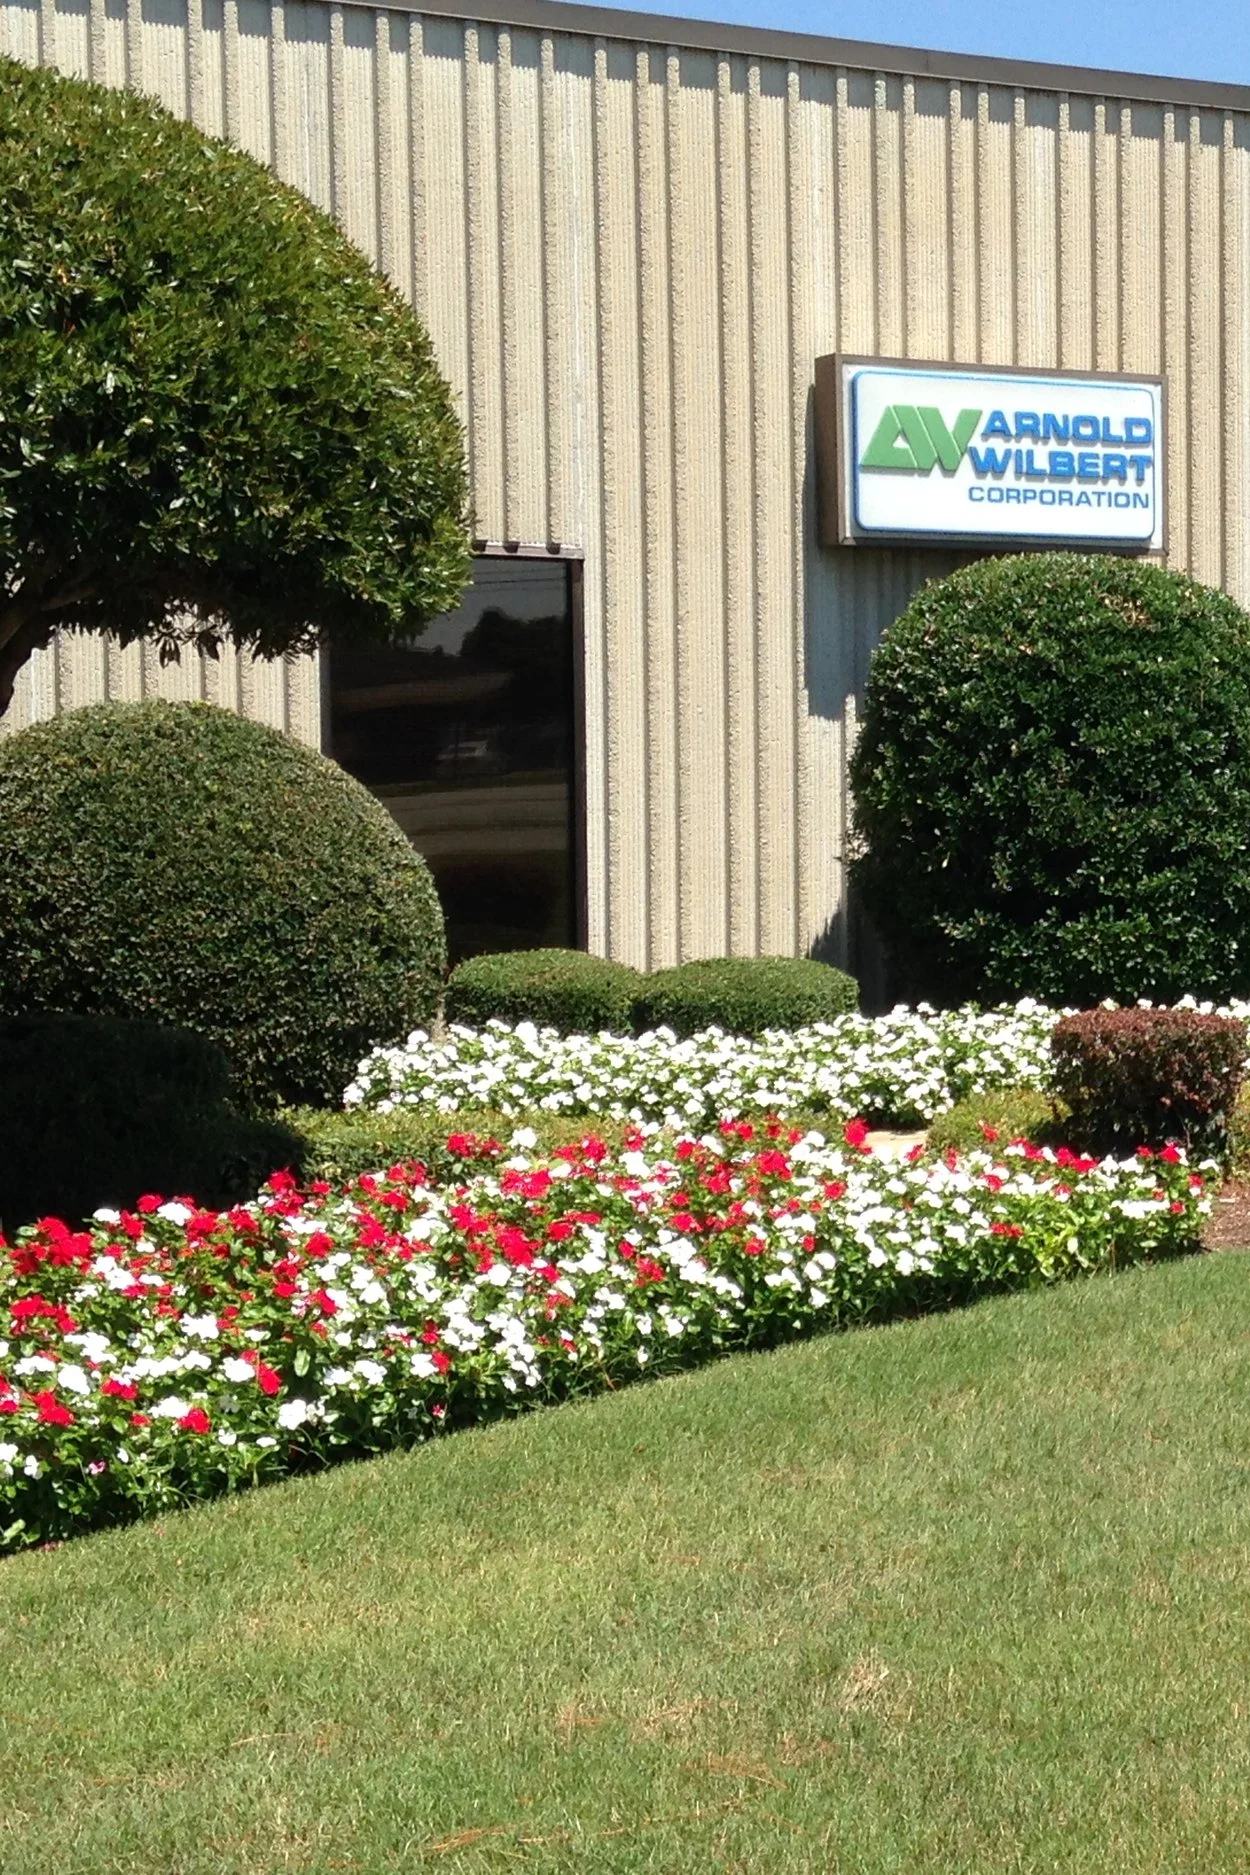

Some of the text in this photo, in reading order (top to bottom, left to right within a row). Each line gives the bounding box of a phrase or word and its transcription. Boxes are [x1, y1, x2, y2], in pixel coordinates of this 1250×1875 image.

[981, 410, 1153, 444] ARNOLD
[968, 446, 1153, 482] WILBERT
[968, 486, 1149, 509] CORPORATION
